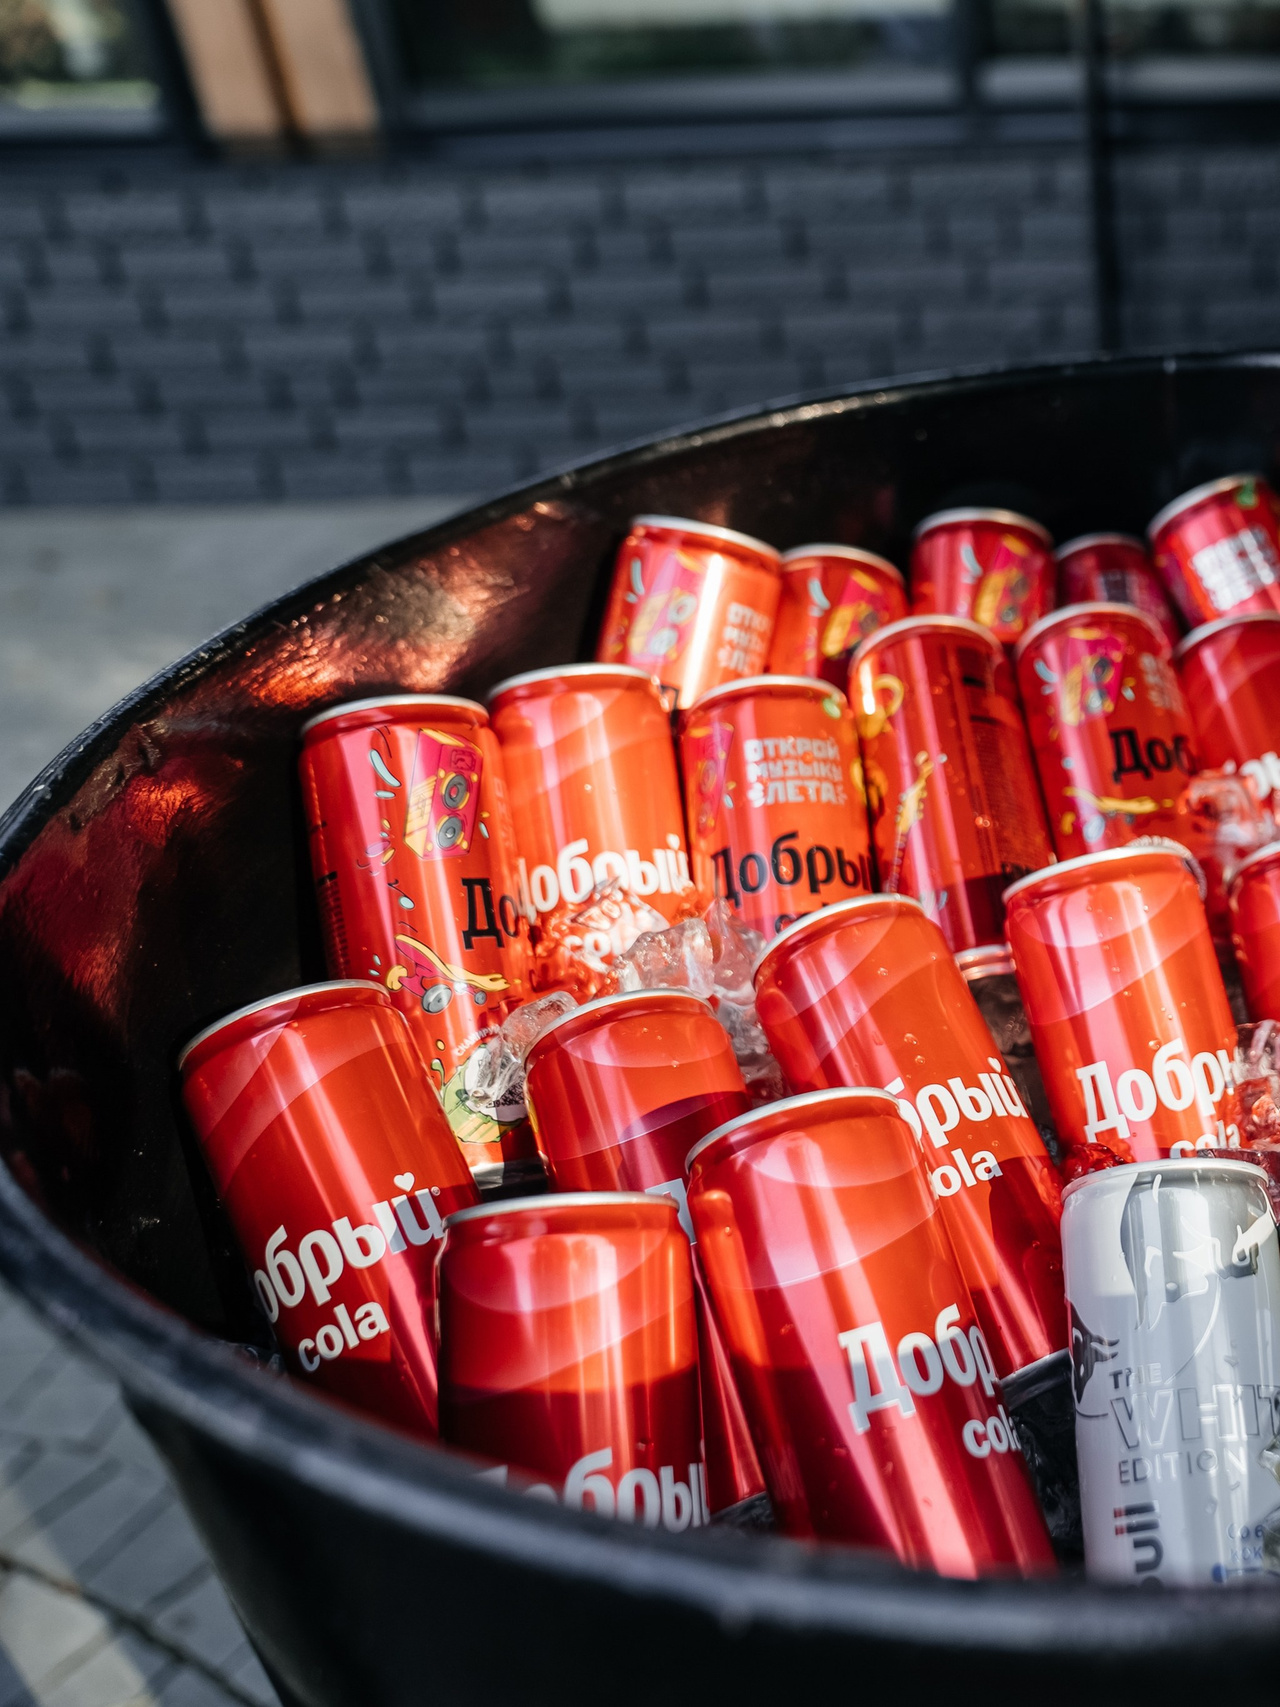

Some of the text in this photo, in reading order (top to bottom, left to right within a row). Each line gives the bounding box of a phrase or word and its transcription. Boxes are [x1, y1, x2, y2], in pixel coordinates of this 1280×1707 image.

[711, 831, 873, 908] Добры
[928, 1148, 1003, 1197] ola
[298, 1302, 390, 1372] cola
[1109, 1363, 1163, 1389] THE
[1119, 1448, 1248, 1485] EDITION
